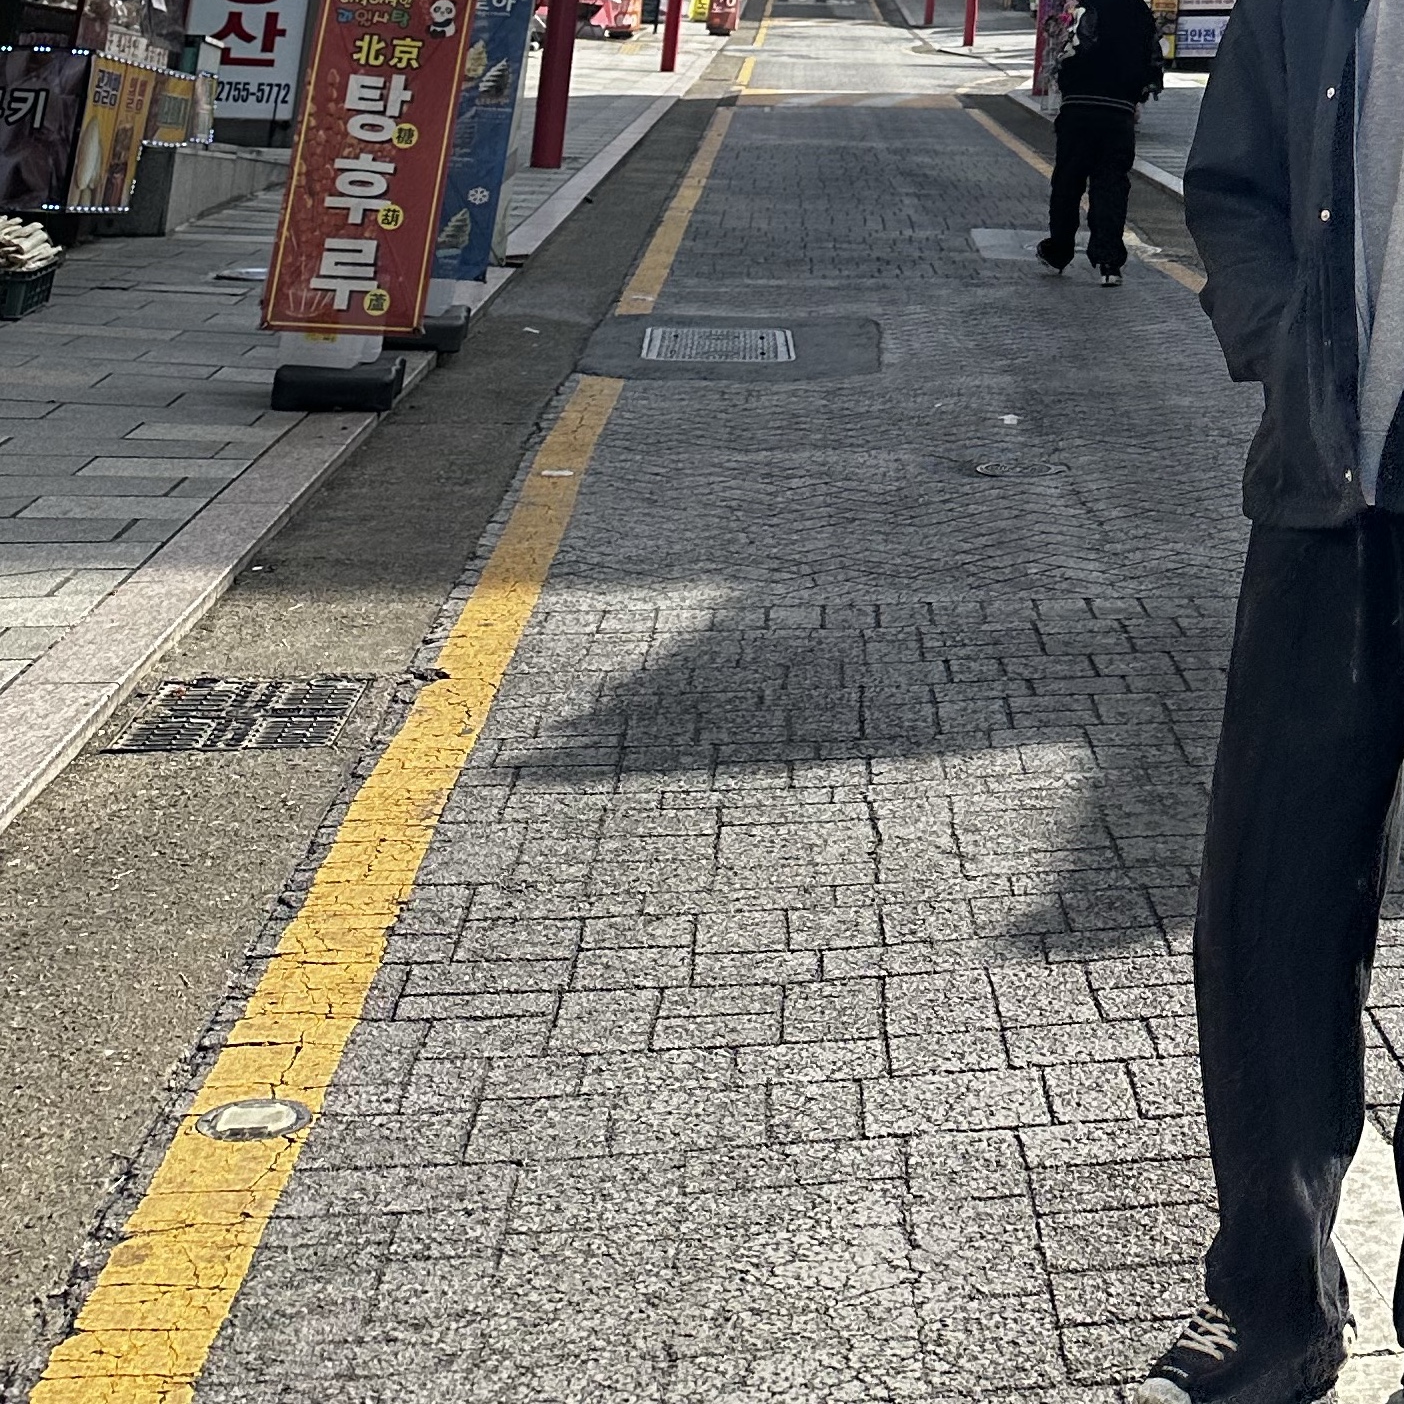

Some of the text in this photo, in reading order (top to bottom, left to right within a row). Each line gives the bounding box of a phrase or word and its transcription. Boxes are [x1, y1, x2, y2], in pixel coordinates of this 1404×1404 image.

[336, 8, 412, 29] 과일사탕
[352, 33, 423, 69] 北京
[0, 88, 49, 130] 키
[215, 80, 291, 104] 2755-5772
[310, 73, 413, 311] 탕후루
